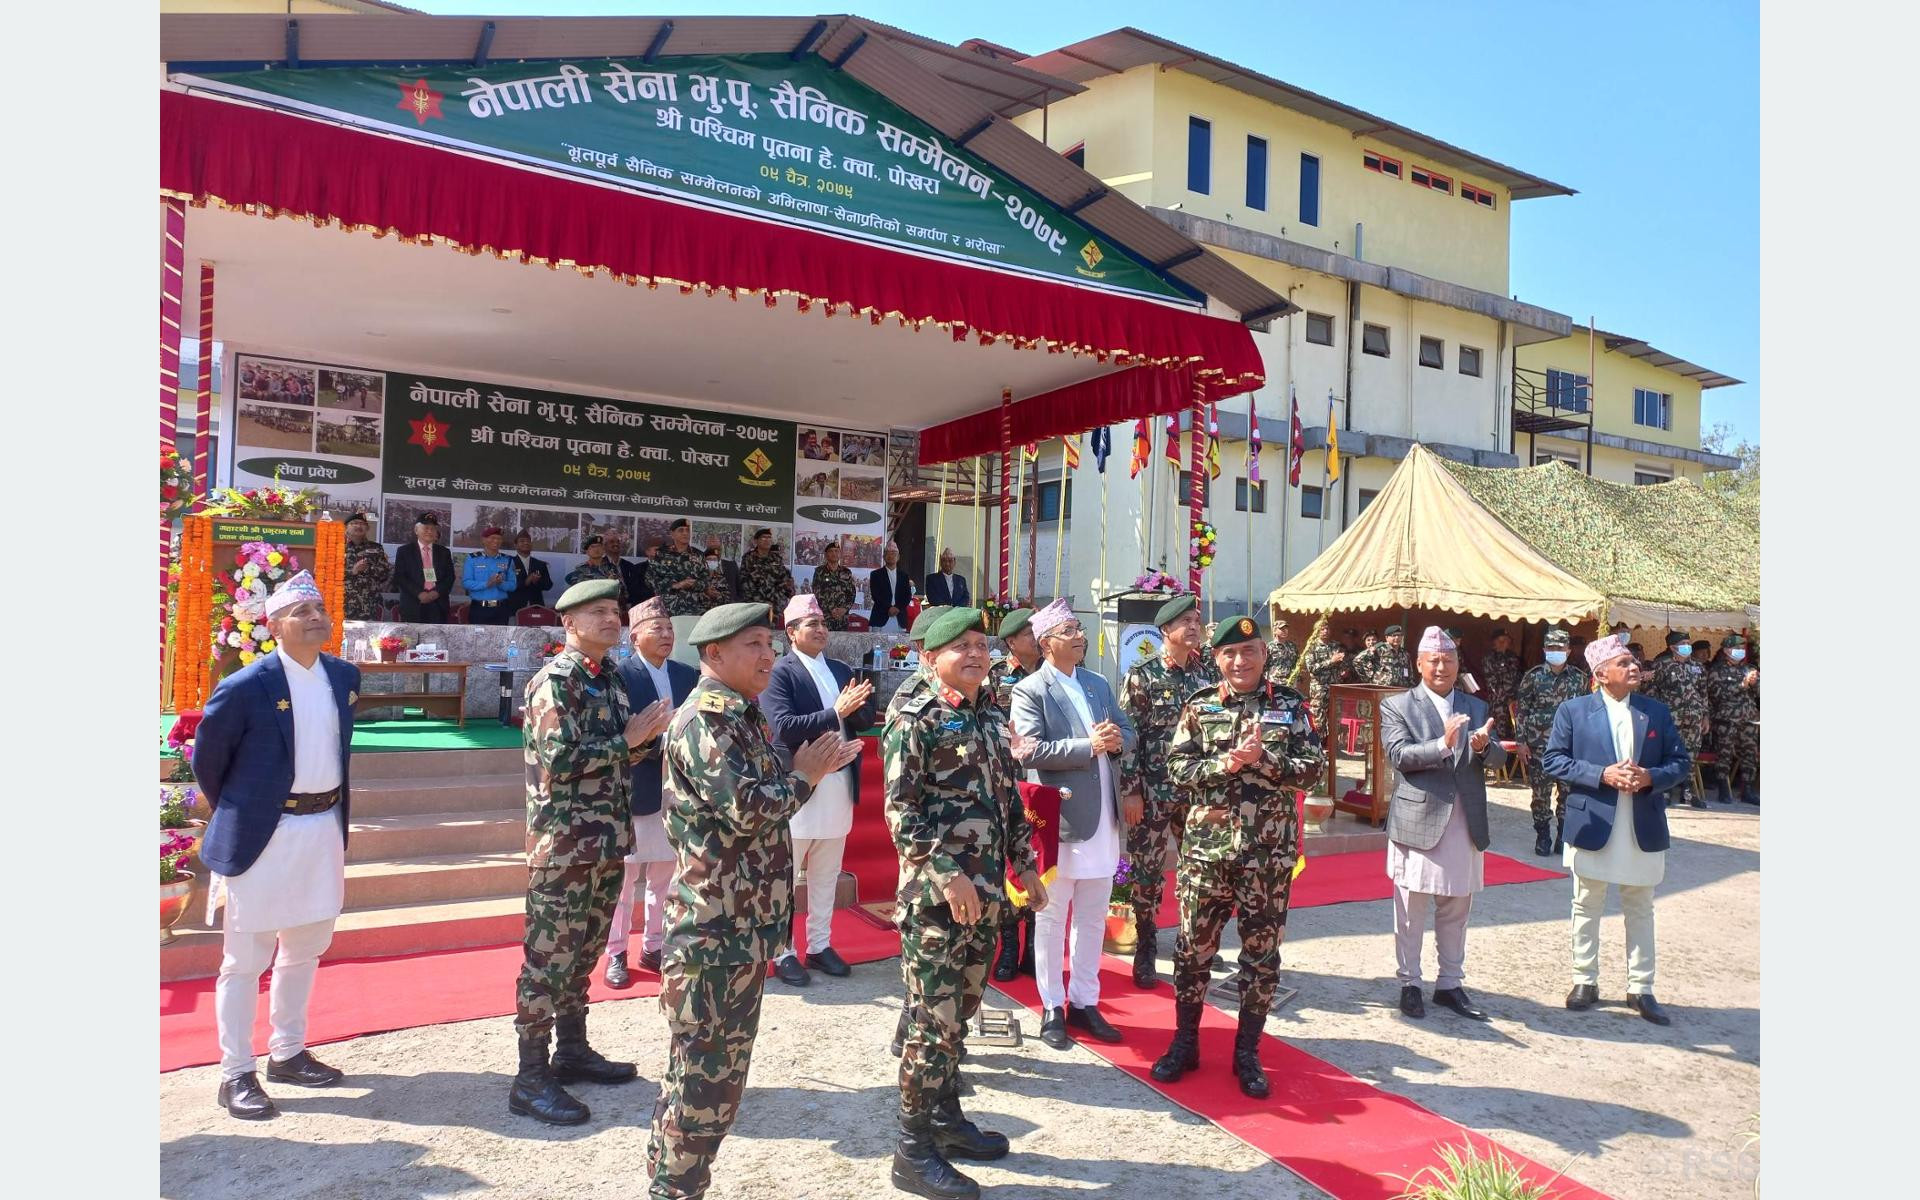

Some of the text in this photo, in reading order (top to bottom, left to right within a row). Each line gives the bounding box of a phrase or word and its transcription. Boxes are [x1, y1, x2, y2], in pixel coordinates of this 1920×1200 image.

[461, 64, 593, 118] नेपाली
[600, 63, 678, 103] सेना
[769, 80, 868, 137] सैनिक
[656, 108, 683, 131] श्री
[689, 115, 756, 149] पश्चिम
[762, 135, 812, 164] पृतना
[818, 146, 837, 169] हे.
[887, 164, 940, 195] पोखरा
[625, 156, 674, 179] सैनिक
[680, 171, 762, 201] सम्मेलनको
[905, 224, 948, 243] समर्पण
[952, 234, 961, 246] र
[409, 381, 481, 409] नेपाली
[487, 391, 532, 415] सेना
[585, 403, 644, 427] सैनिक
[471, 425, 495, 444] श्री
[501, 428, 561, 451] पश्चिम
[566, 438, 613, 456] पृतना
[617, 440, 634, 459] हे.
[681, 447, 730, 467] पोखरा
[278, 462, 338, 479] सेवा प्रवेश
[452, 479, 493, 493] सैनिक
[499, 484, 567, 498] सम्मेलनको
[693, 500, 730, 510] समर्पण
[735, 503, 741, 512] र
